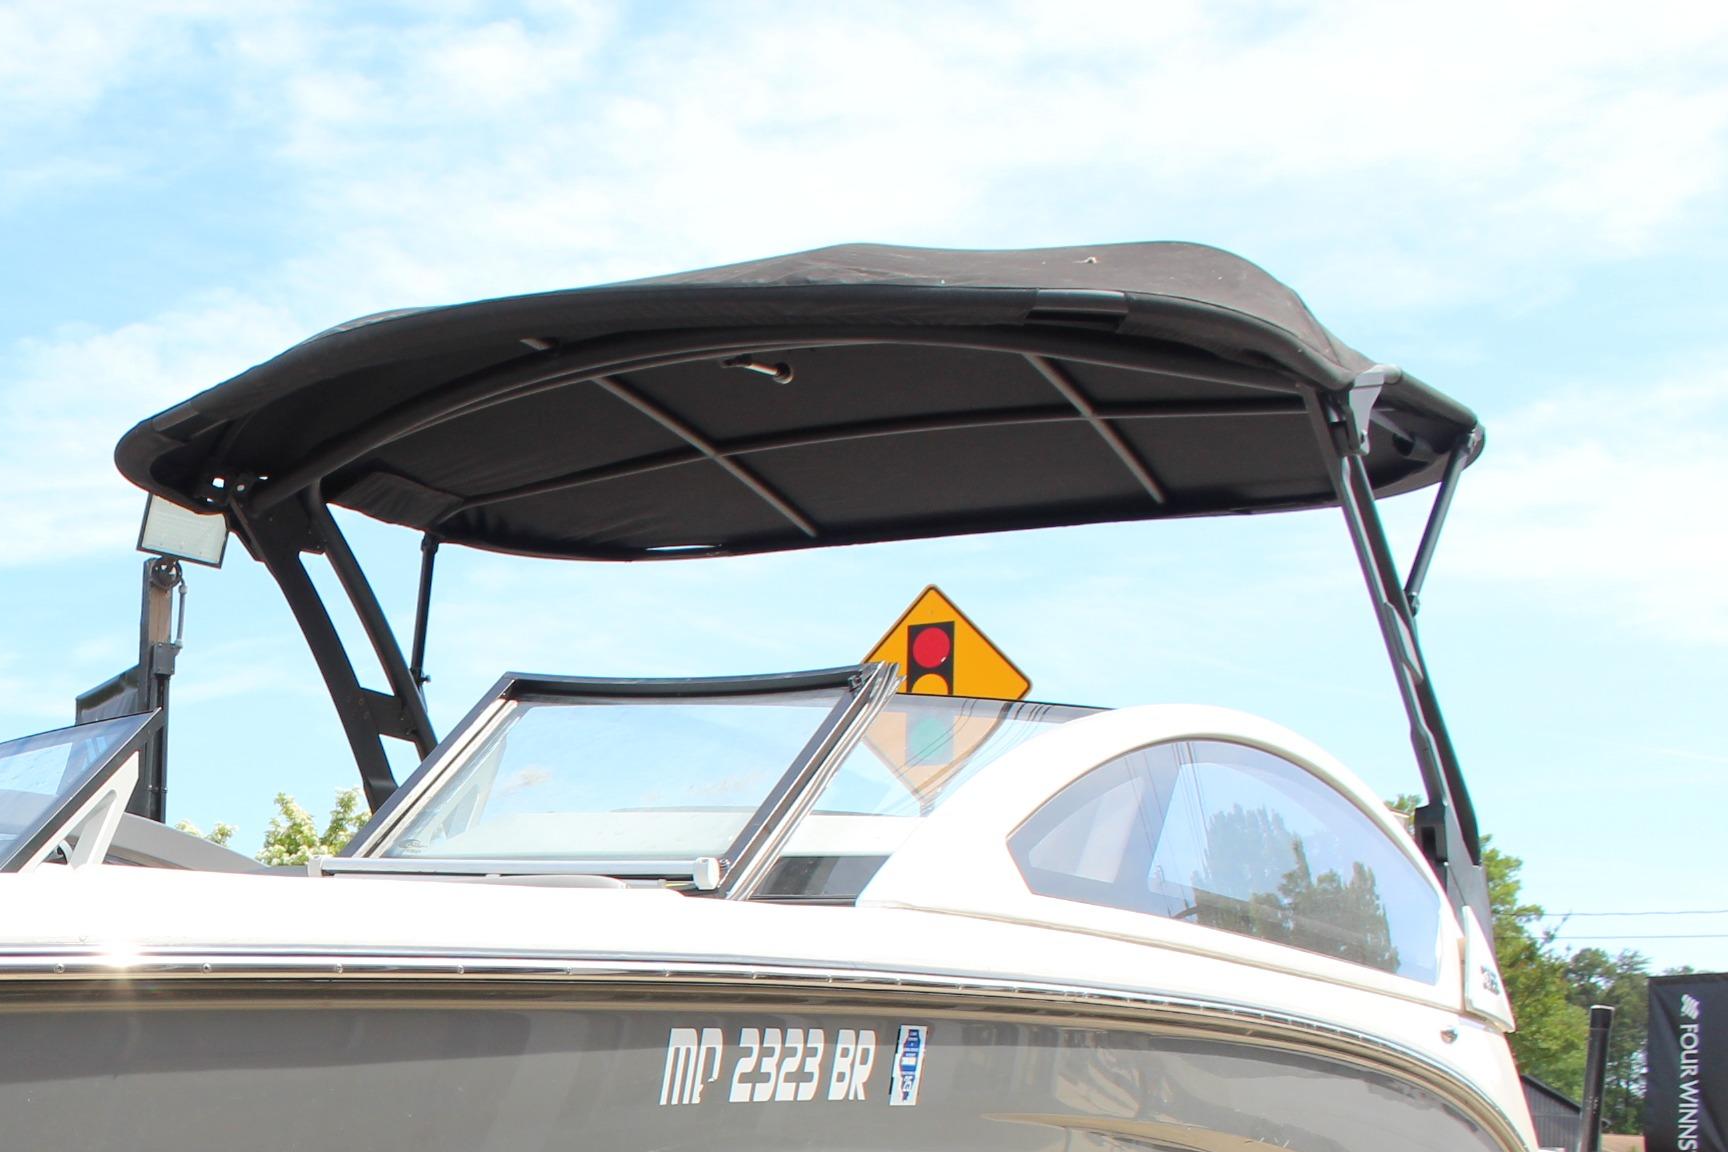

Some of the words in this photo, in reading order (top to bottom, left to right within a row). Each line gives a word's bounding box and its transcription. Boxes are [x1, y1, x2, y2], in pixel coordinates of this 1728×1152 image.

[729, 1028, 824, 1102] 2323
[828, 1029, 876, 1100] BR
[1679, 1024, 1700, 1078] FOUR
[1677, 1079, 1700, 1152] WINNS
